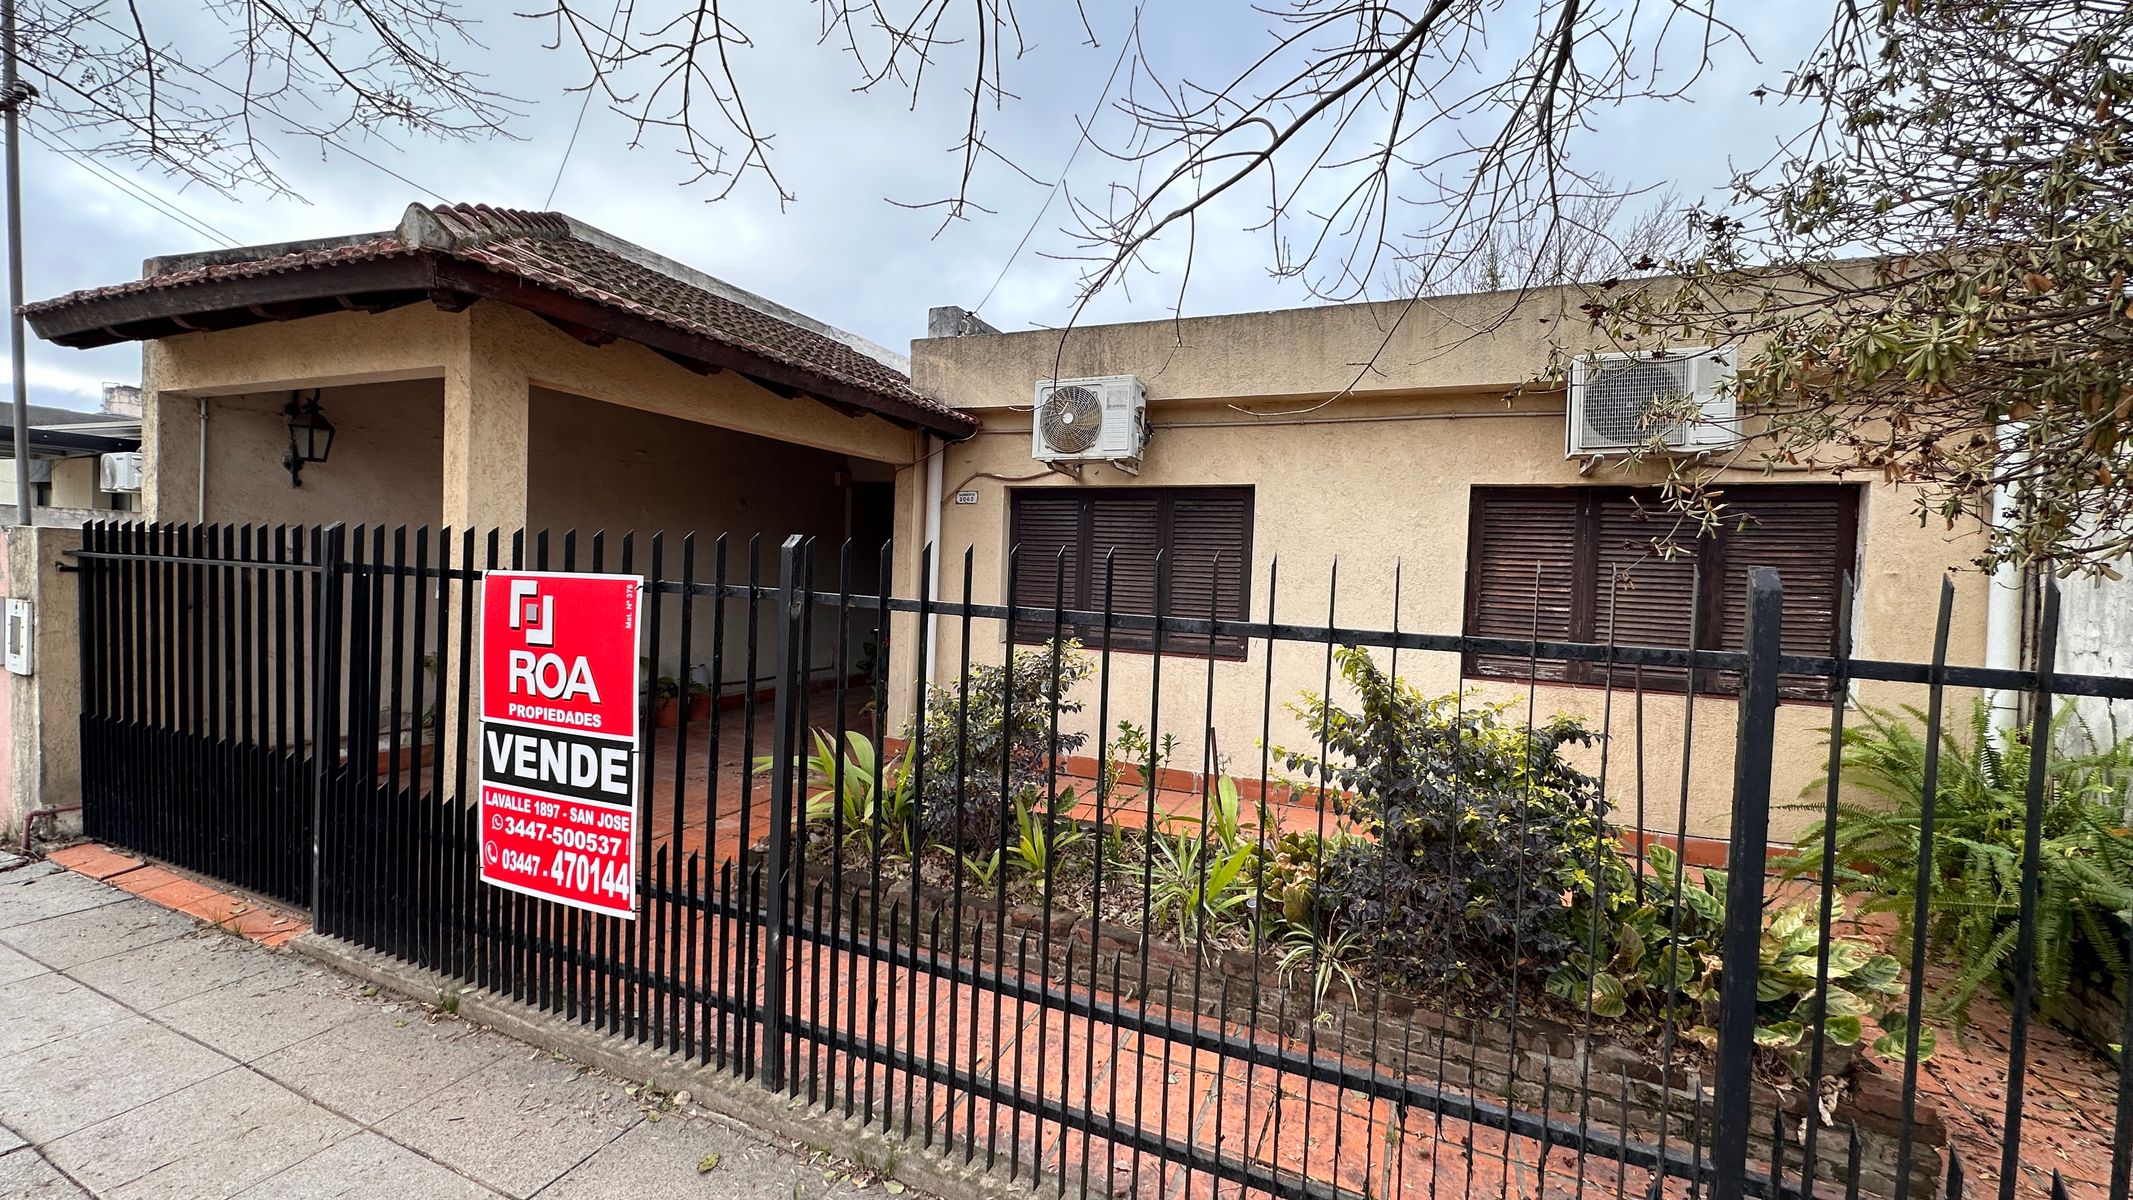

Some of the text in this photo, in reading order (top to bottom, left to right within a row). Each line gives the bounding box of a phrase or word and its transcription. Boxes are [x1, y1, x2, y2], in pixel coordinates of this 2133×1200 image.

[509, 650, 601, 703] ROA
[508, 703, 602, 727] PROPIEDADES
[486, 731, 628, 794] VENDE
[485, 791, 531, 813] LAVALLE
[533, 801, 560, 819] 1897
[569, 807, 594, 826] SAN
[597, 812, 630, 832] JOSE
[504, 816, 622, 857] 3447-500537
[501, 848, 541, 877] 03447
[551, 849, 630, 901] 470144
